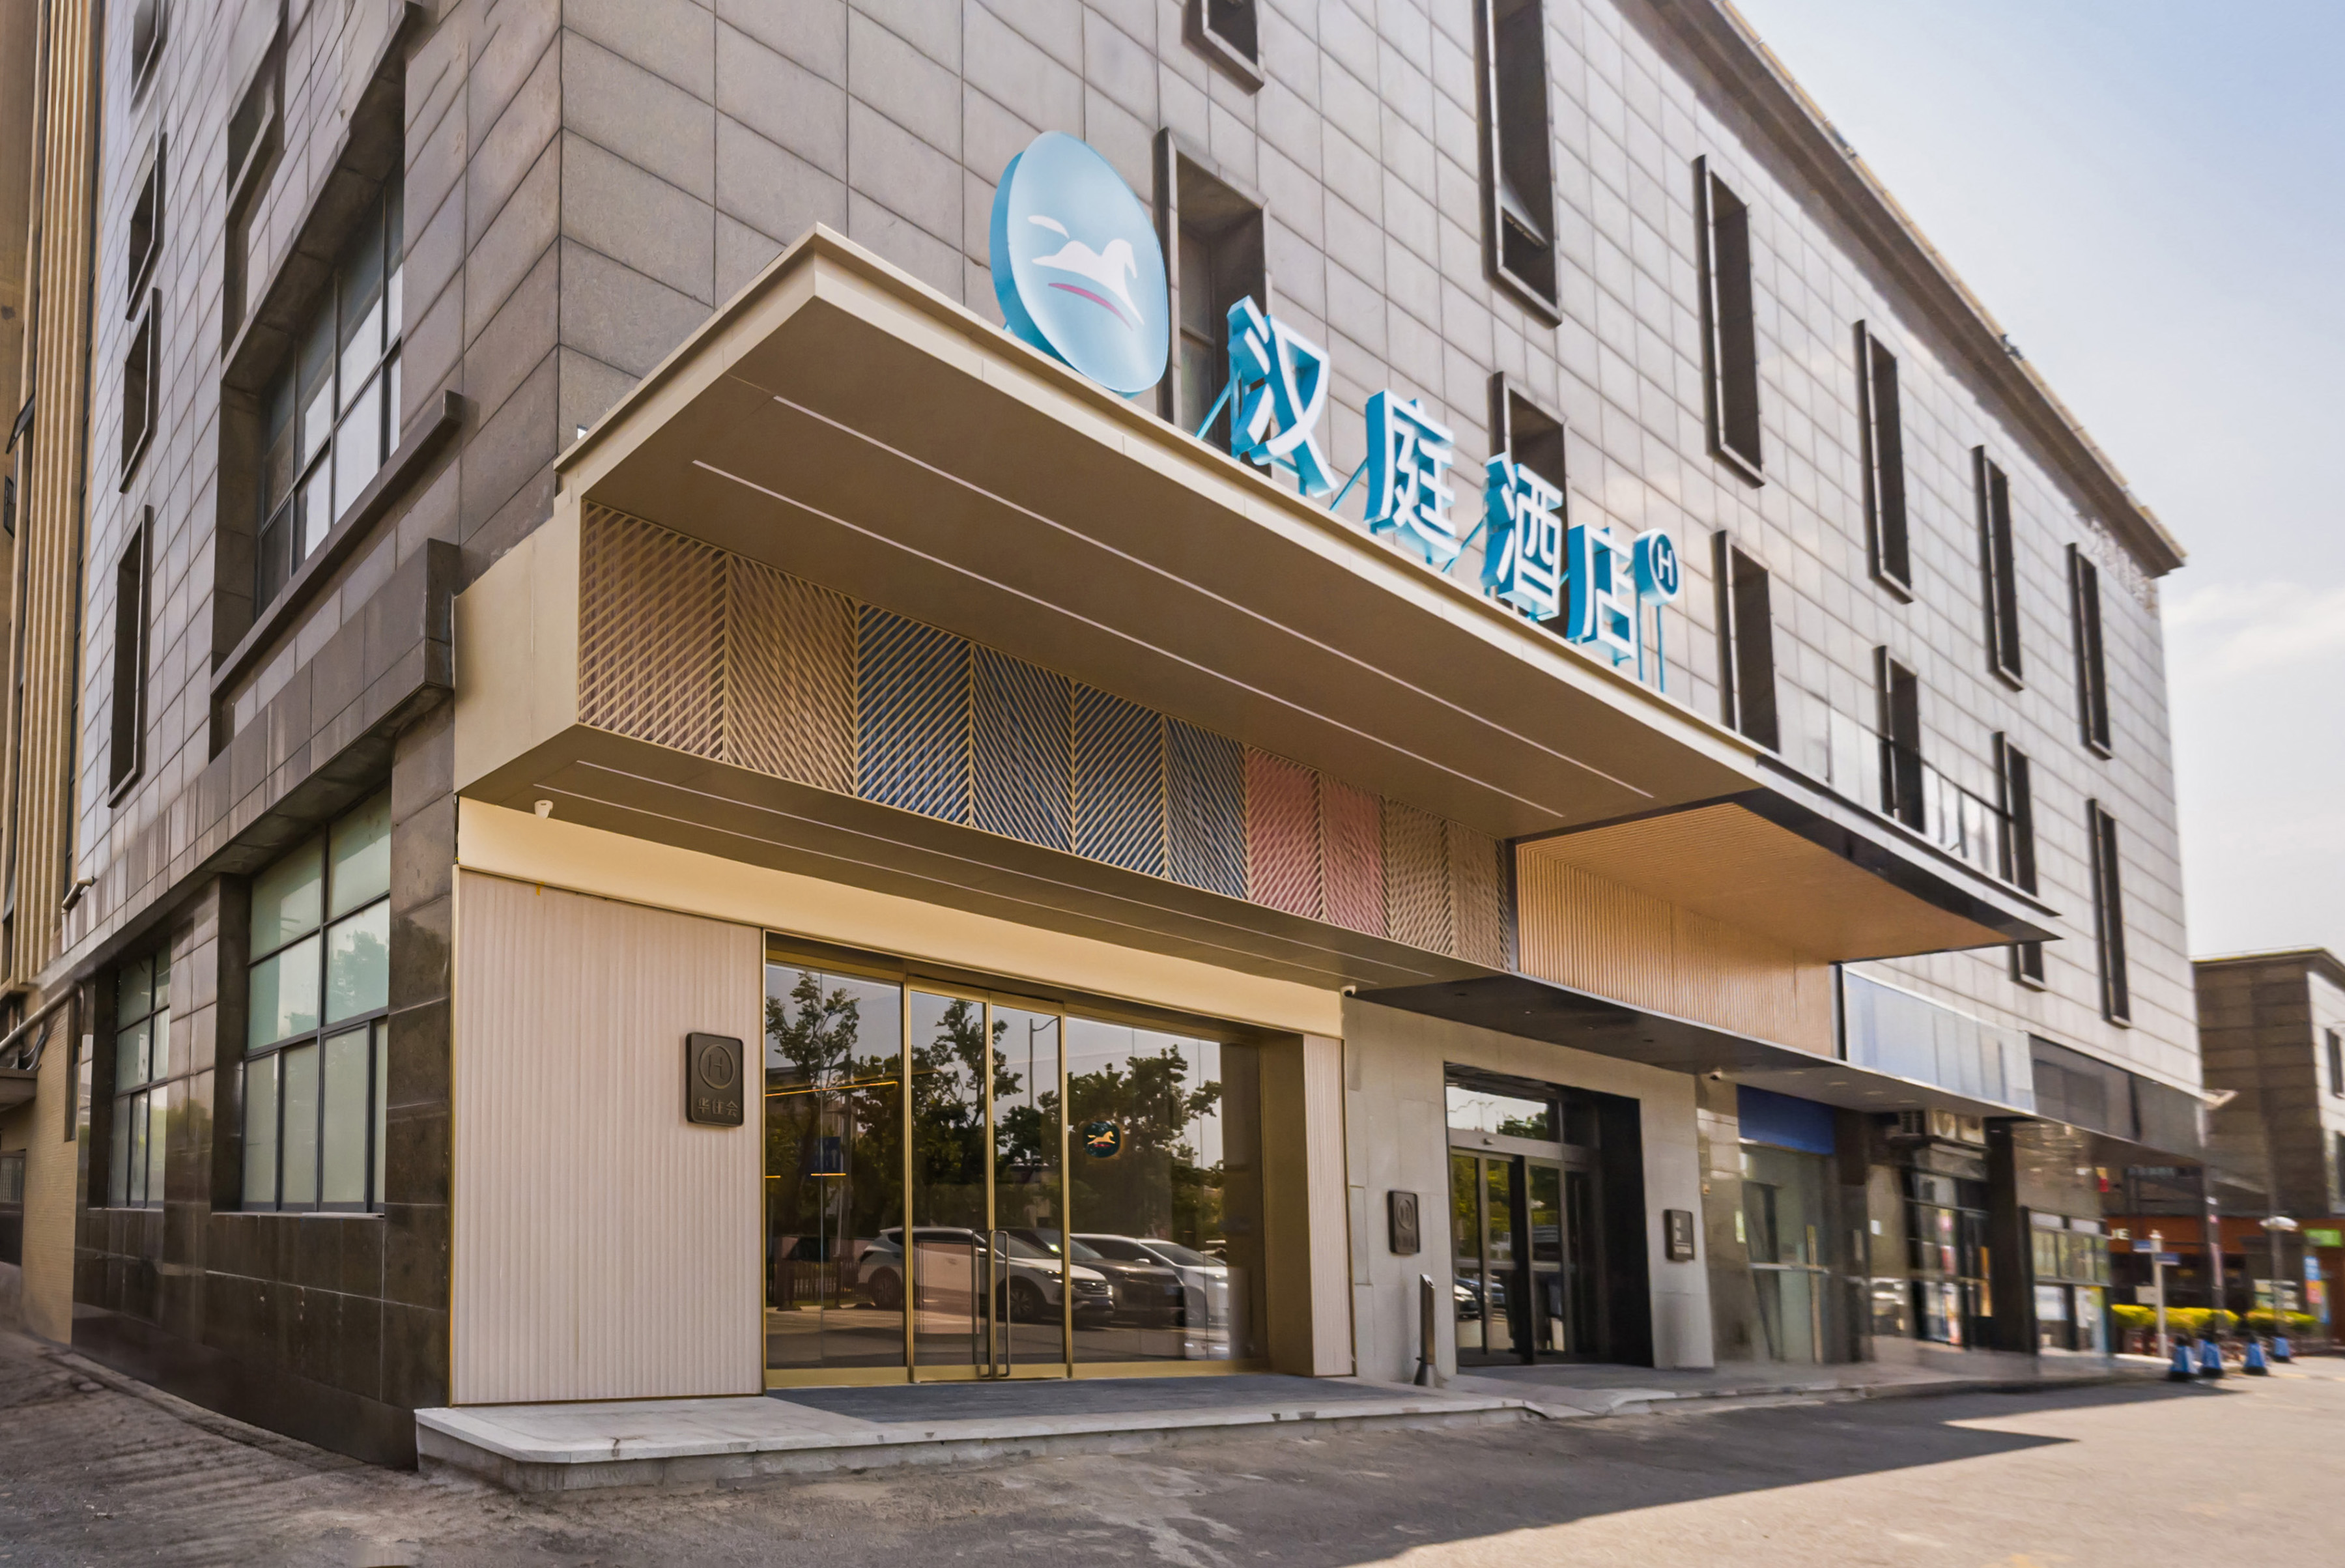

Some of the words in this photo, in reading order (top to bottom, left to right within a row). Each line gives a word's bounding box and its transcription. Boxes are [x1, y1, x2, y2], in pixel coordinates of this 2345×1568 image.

[1227, 295, 1638, 661] 汉庭酒店
[1657, 543, 1673, 587] H
